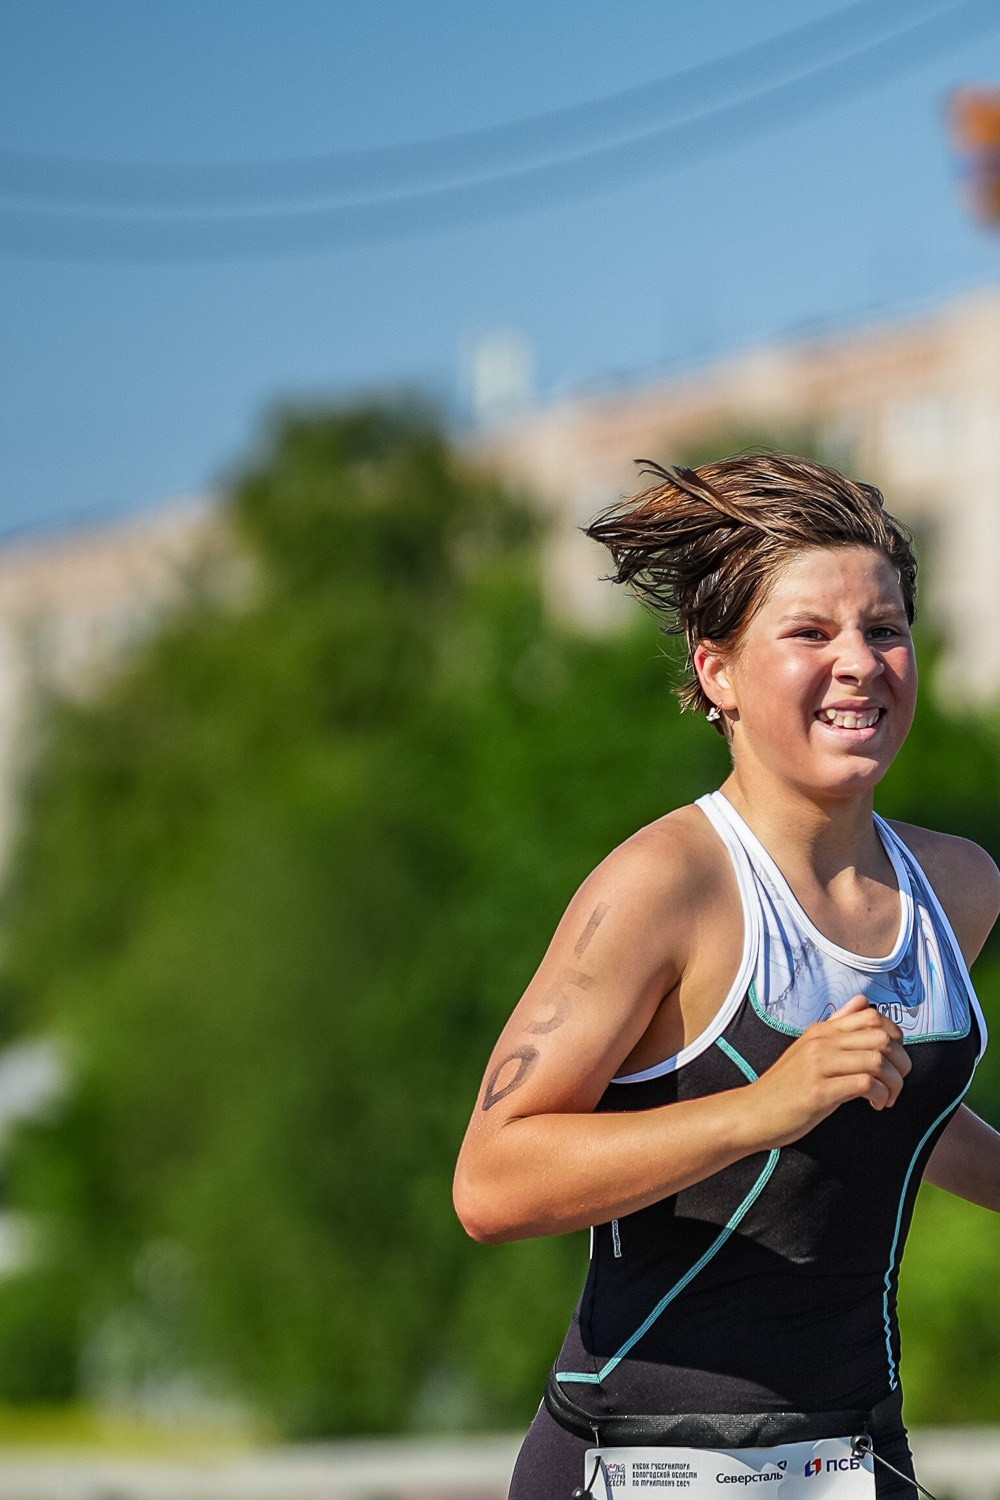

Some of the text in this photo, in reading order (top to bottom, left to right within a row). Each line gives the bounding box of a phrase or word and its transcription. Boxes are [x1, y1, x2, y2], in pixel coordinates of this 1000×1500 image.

[826, 1457, 861, 1472] ПСБ
[632, 1471, 670, 1479] ВОЛОГОДСКОЙ
[716, 1471, 783, 1486] Северсталь
